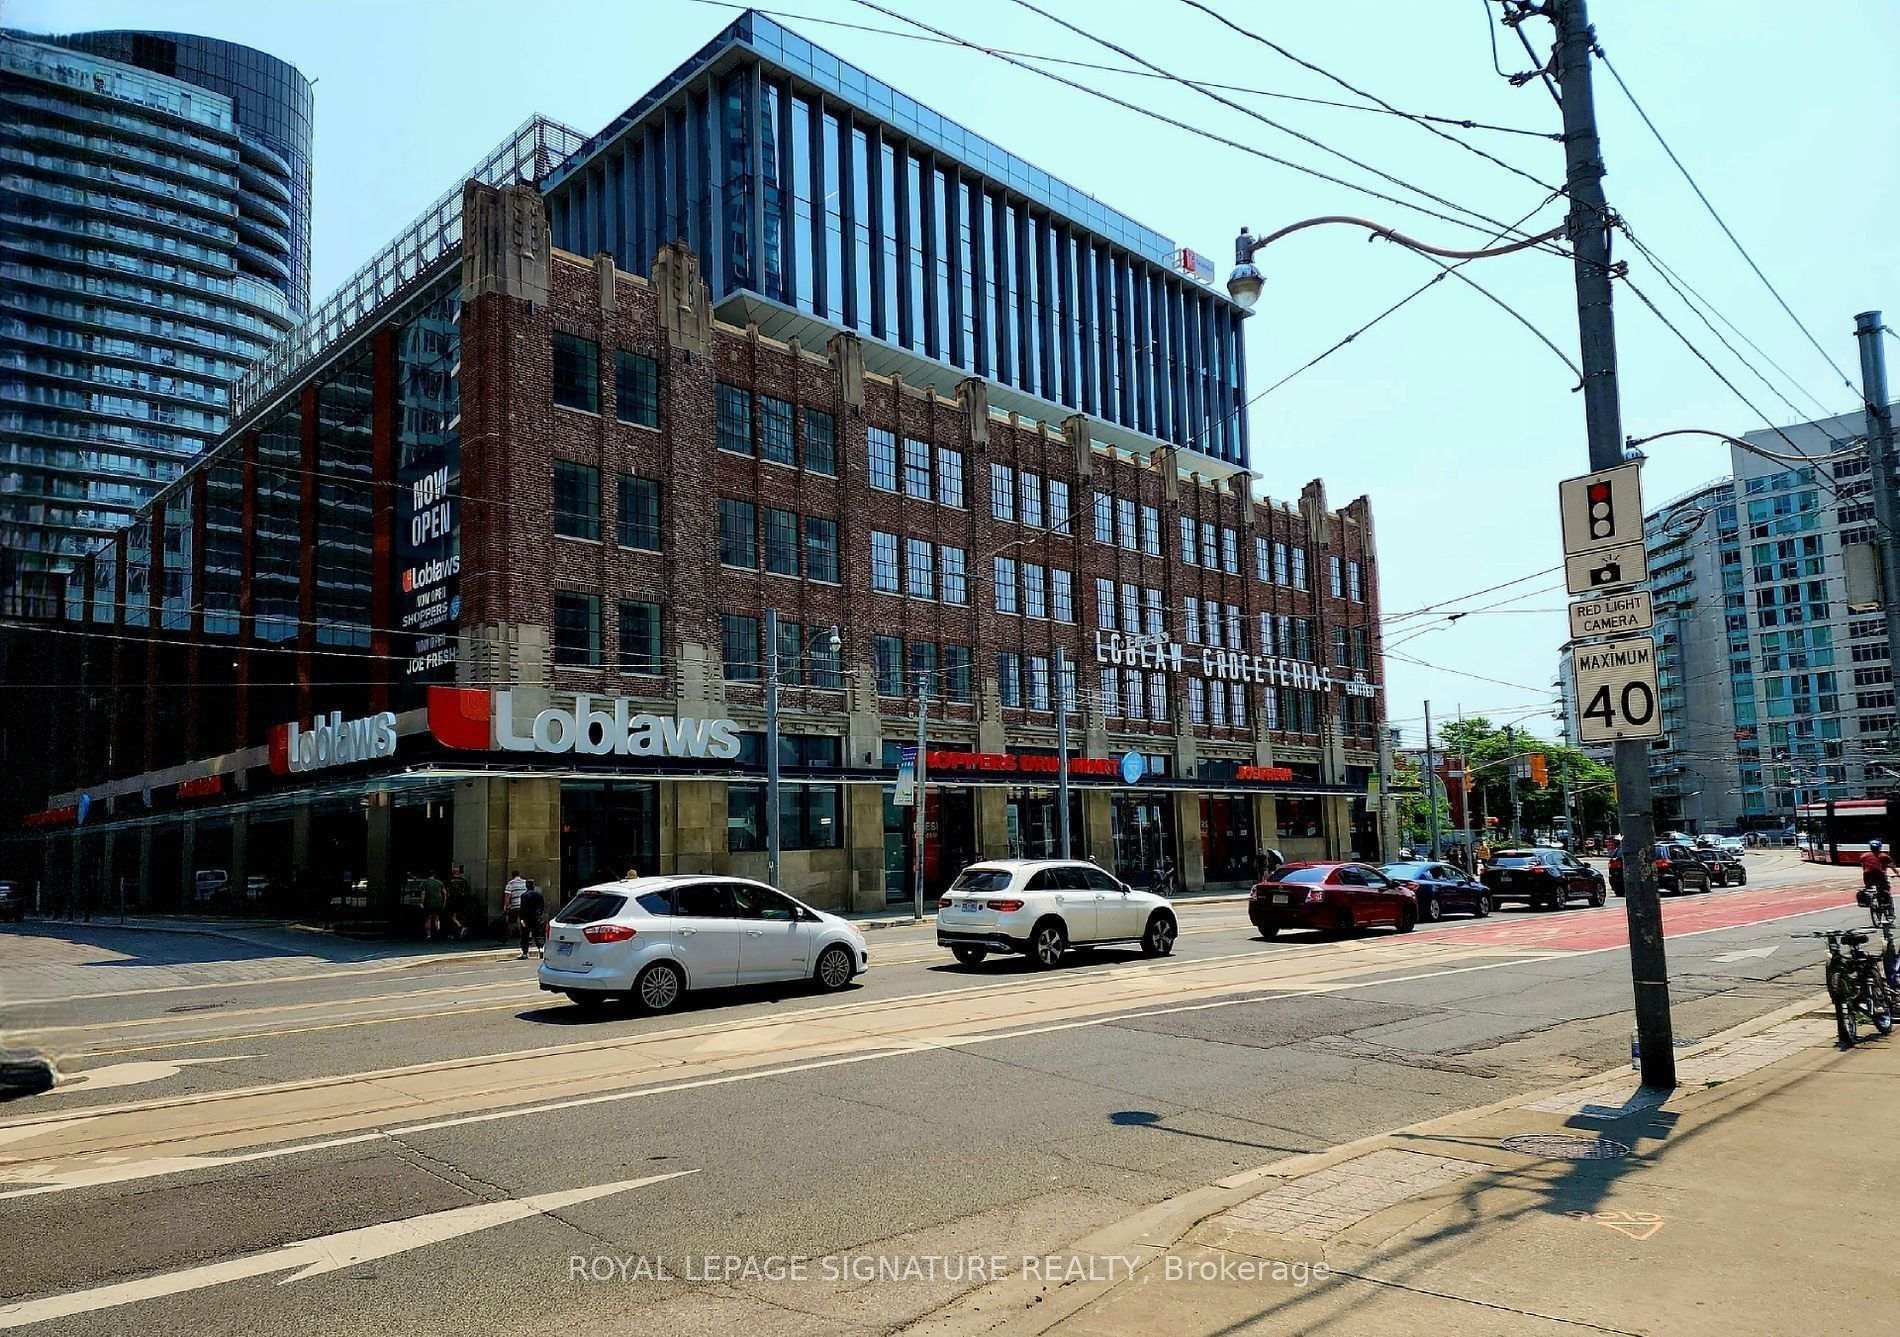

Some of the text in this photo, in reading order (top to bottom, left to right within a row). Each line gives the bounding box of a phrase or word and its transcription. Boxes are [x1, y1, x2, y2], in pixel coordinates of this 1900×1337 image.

[413, 465, 448, 511] NOW
[412, 501, 450, 546] OPEN
[412, 555, 460, 589] Loblaws
[402, 601, 448, 627] SHOPPERS
[1577, 597, 1641, 617] RED LIGHT
[1584, 616, 1638, 632] CAMERA
[406, 647, 456, 675] JOE FRESH
[1202, 648, 1332, 692] GROCETERIAS
[1580, 649, 1649, 671] MAXIMUM
[495, 689, 741, 759] Loblaws
[1583, 681, 1654, 728] 40
[287, 710, 397, 773] Loblaws
